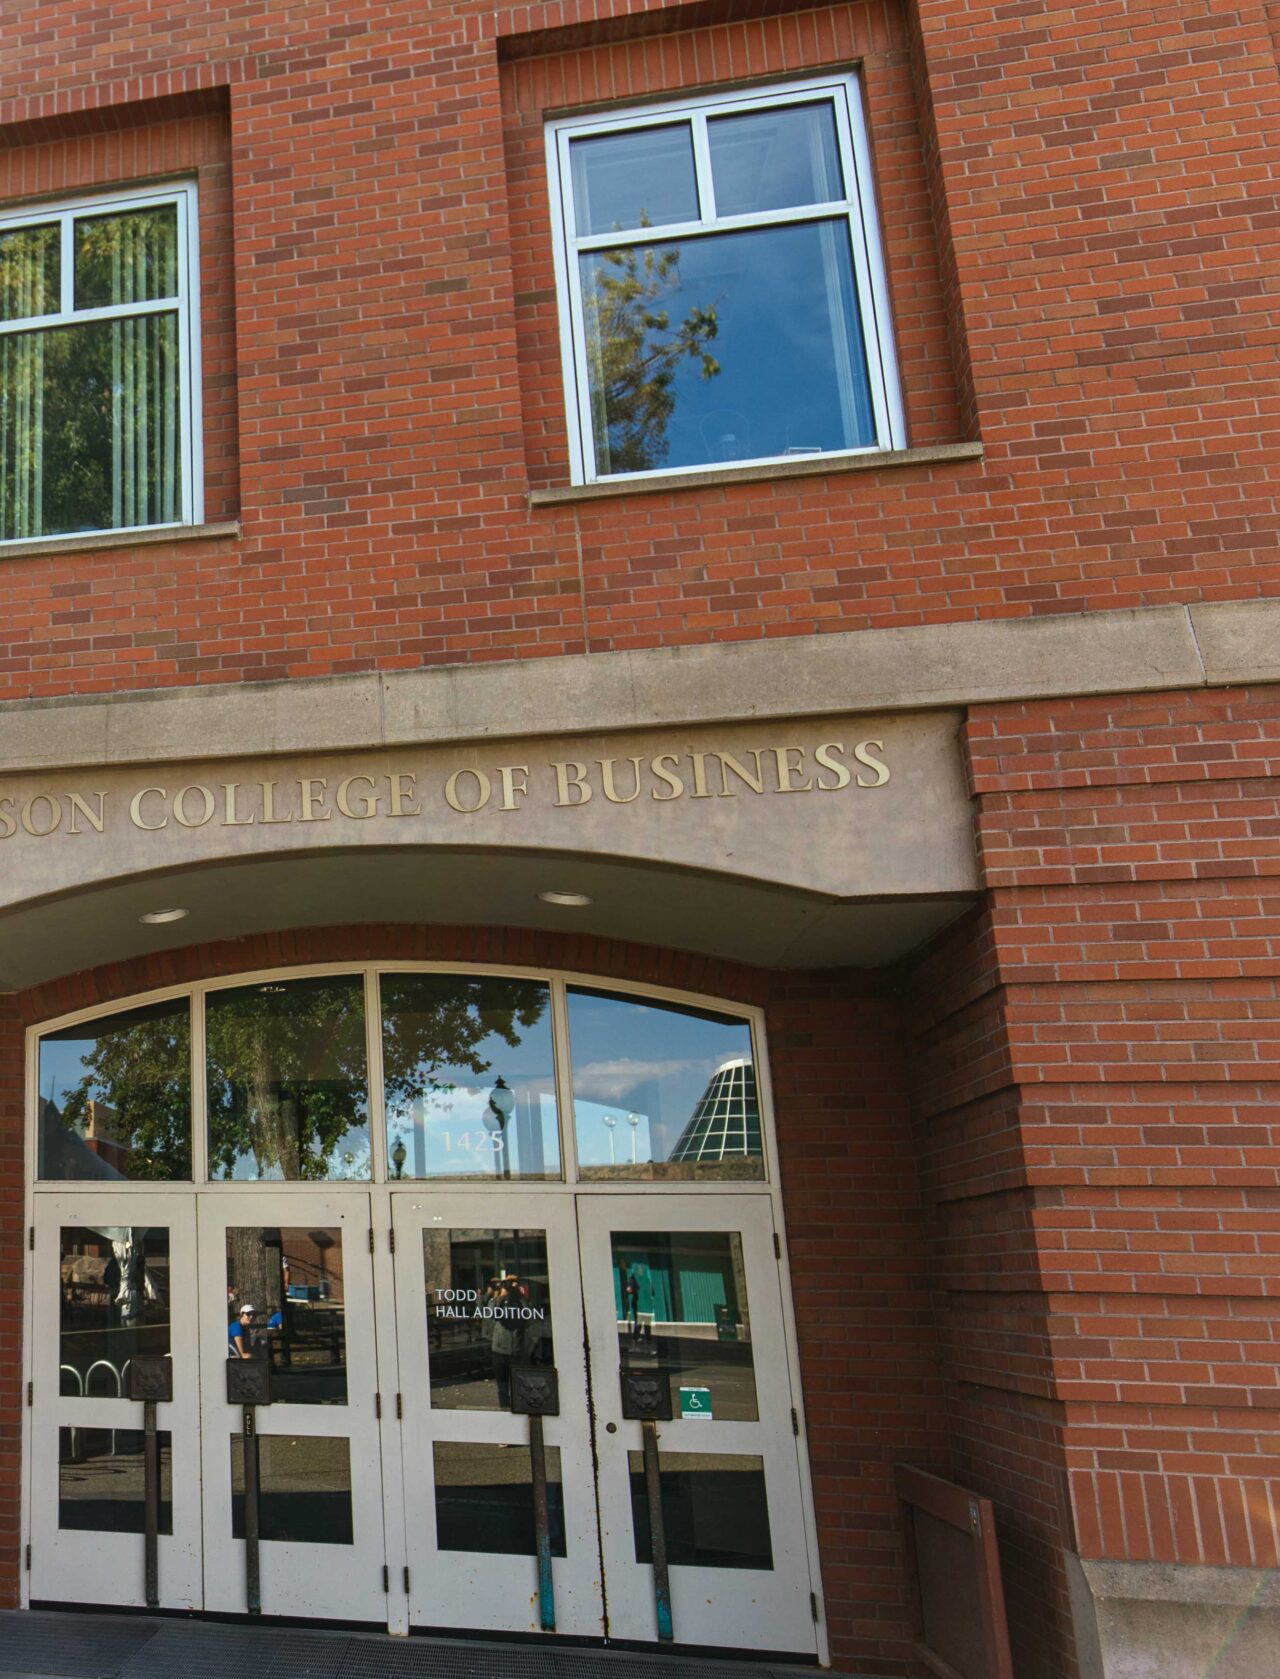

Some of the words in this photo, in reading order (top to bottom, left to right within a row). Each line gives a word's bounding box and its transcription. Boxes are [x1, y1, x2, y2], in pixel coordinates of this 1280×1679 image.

[129, 773, 423, 830] COLLEGE
[444, 765, 530, 812] OF
[550, 740, 891, 806] BUSINESS
[441, 1130, 504, 1152] 1425
[435, 1288, 477, 1301] TODD
[436, 1305, 470, 1318] HALL
[473, 1306, 544, 1320] ADDITION
